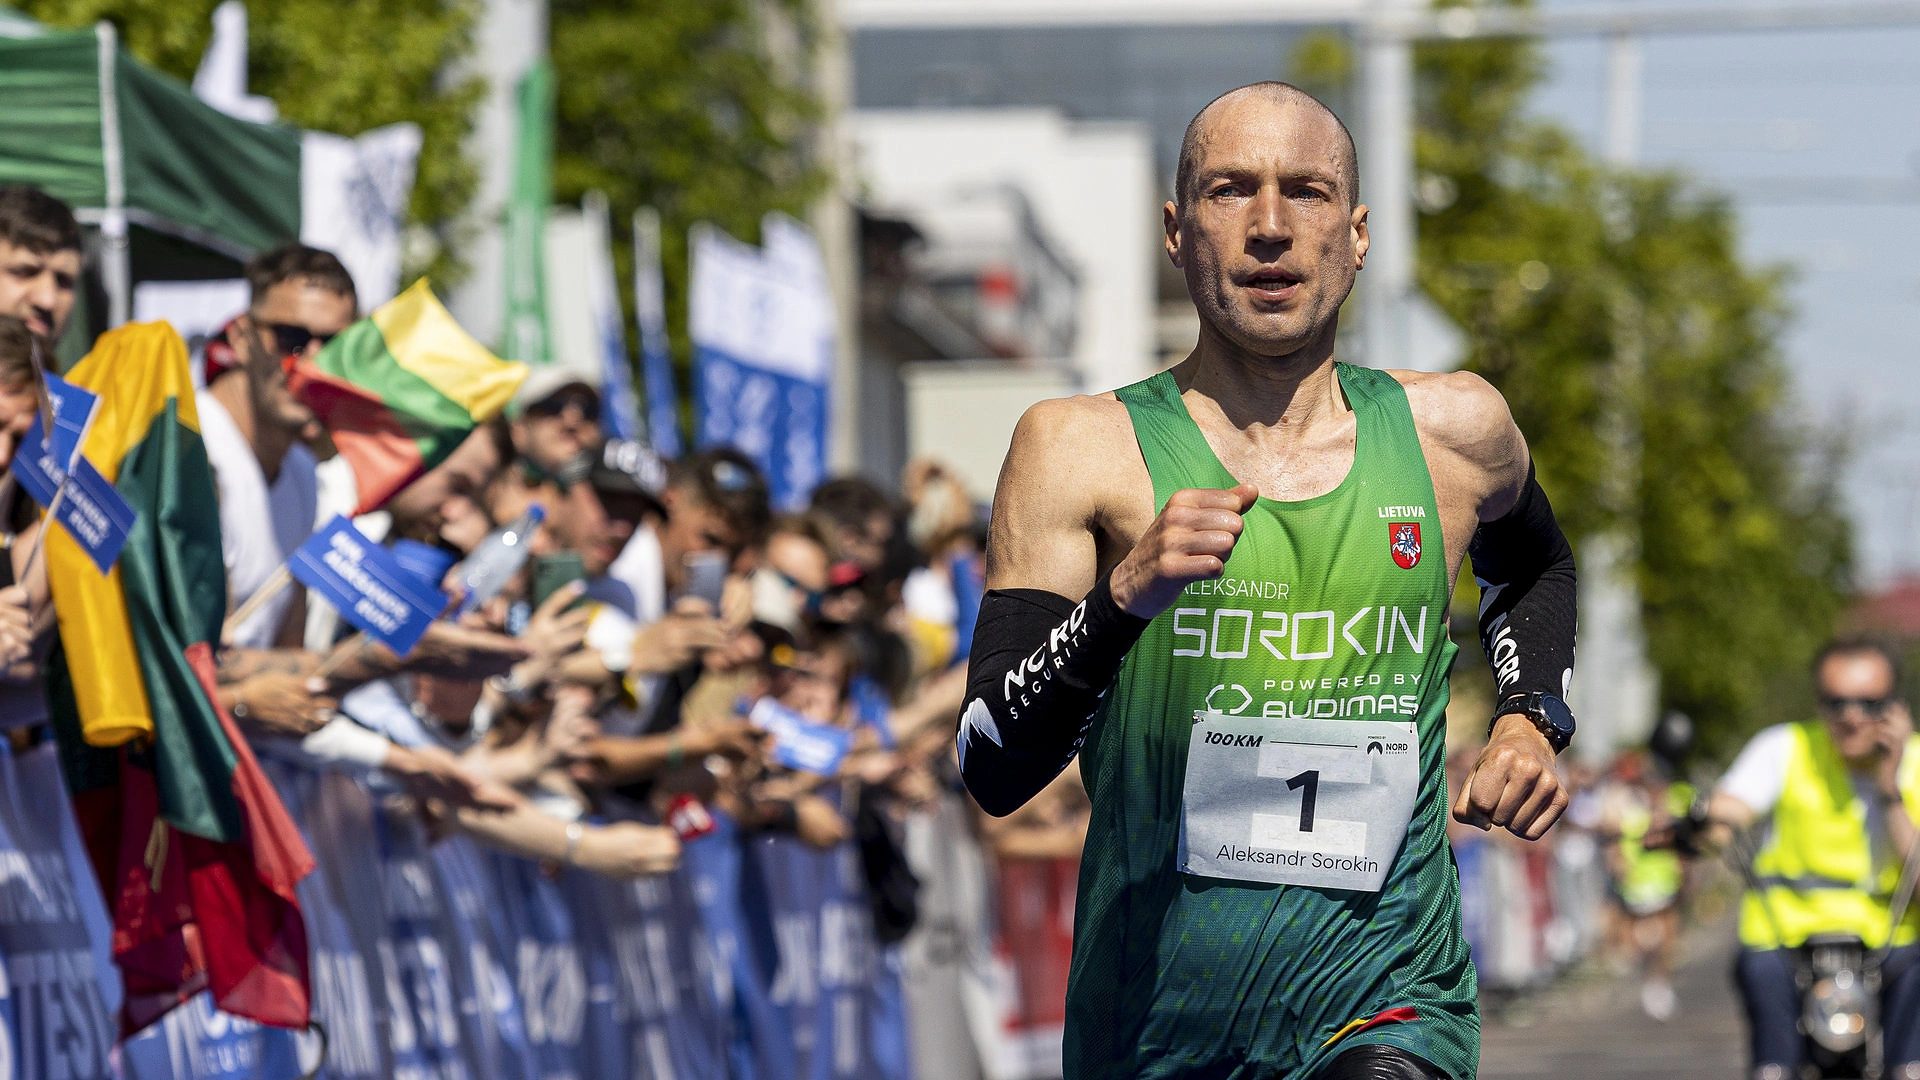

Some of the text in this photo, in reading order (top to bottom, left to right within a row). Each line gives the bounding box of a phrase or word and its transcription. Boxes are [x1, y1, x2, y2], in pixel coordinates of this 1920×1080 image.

[1378, 505, 1426, 518] LIETUVA
[1173, 605, 1428, 661] SOROKIN
[1004, 599, 1087, 701] NORD
[1009, 623, 1088, 720] SECURITY
[1264, 673, 1423, 691] POWERED BY
[1262, 694, 1419, 718] AUDIMAS
[1385, 743, 1408, 751] NORD
[1285, 769, 1320, 833] 1
[1216, 844, 1378, 873] Aleksandr Sorokin
